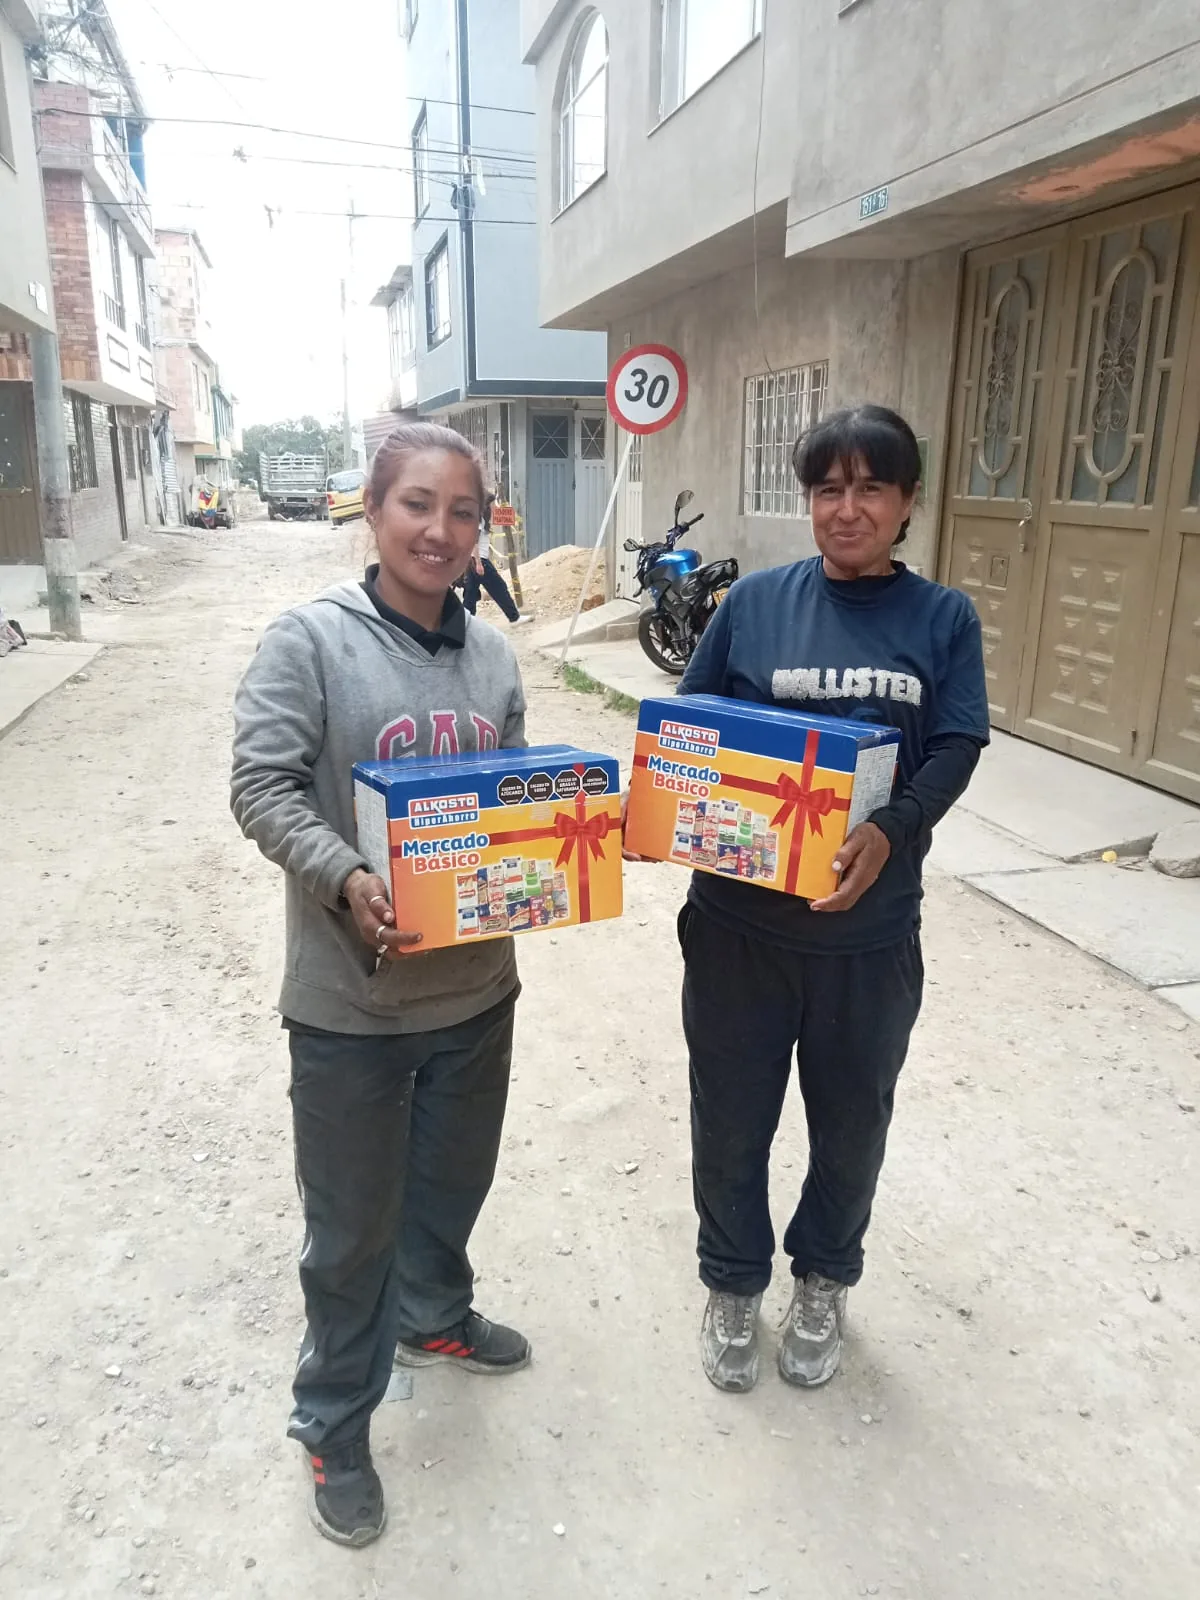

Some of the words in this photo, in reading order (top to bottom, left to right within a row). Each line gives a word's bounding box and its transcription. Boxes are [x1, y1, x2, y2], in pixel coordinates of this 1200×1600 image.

[624, 367, 670, 409] 30
[664, 723, 716, 742] ALKOSTO
[661, 737, 715, 756] HiperAhorro
[648, 754, 720, 784] Mercado
[654, 772, 710, 798] Básico
[414, 796, 476, 814] ALKOSTO
[414, 812, 476, 827] HiperAhorro
[403, 832, 489, 857] Mercado
[414, 852, 480, 874] Básico
